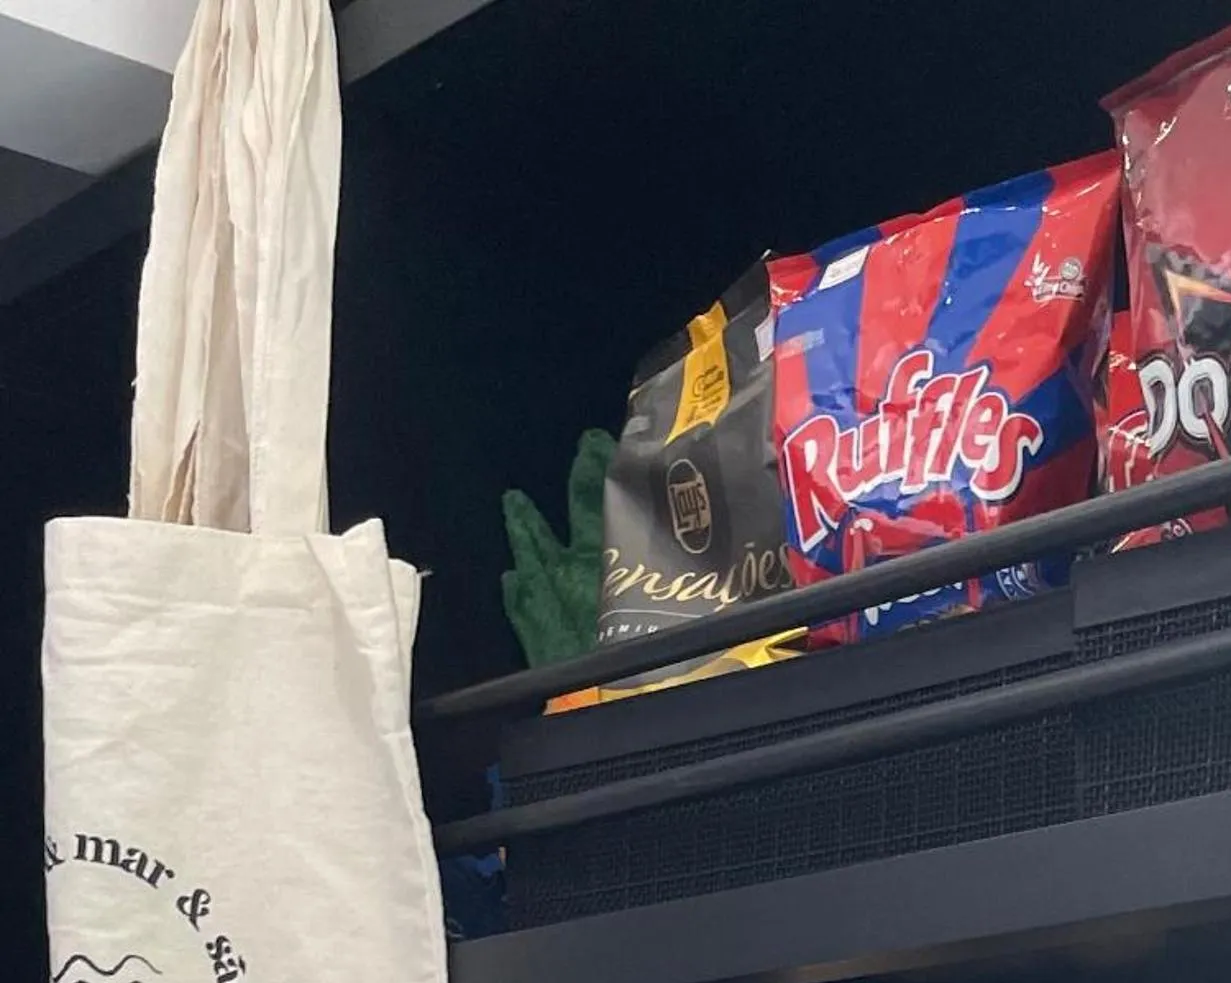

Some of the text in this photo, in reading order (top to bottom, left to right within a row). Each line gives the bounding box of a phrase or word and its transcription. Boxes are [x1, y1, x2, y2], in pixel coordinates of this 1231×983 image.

[783, 350, 1043, 551] Ruffles
[73, 834, 176, 889] mar
[176, 888, 211, 932] &
